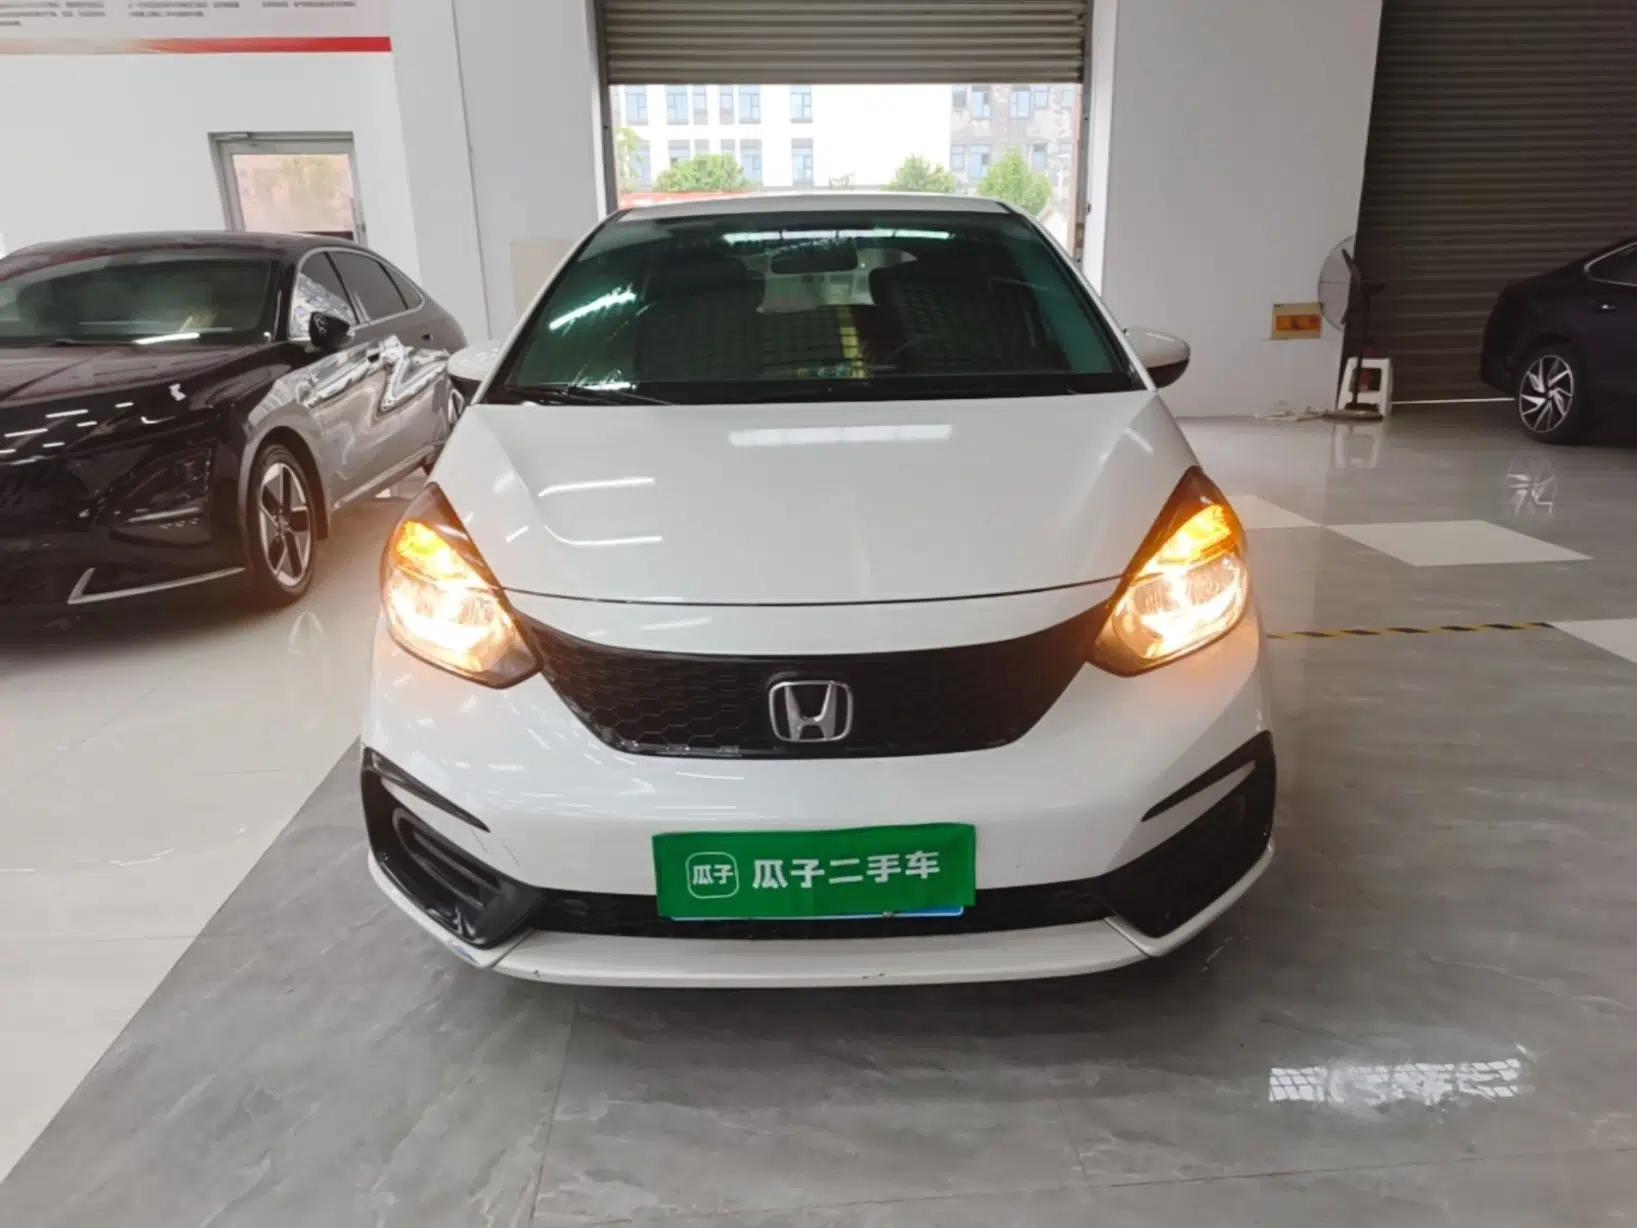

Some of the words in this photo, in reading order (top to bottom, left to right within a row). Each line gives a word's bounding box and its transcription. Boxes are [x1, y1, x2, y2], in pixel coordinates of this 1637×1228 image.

[692, 863, 734, 886] 瓜子
[752, 851, 940, 889] 瓜子二手车
